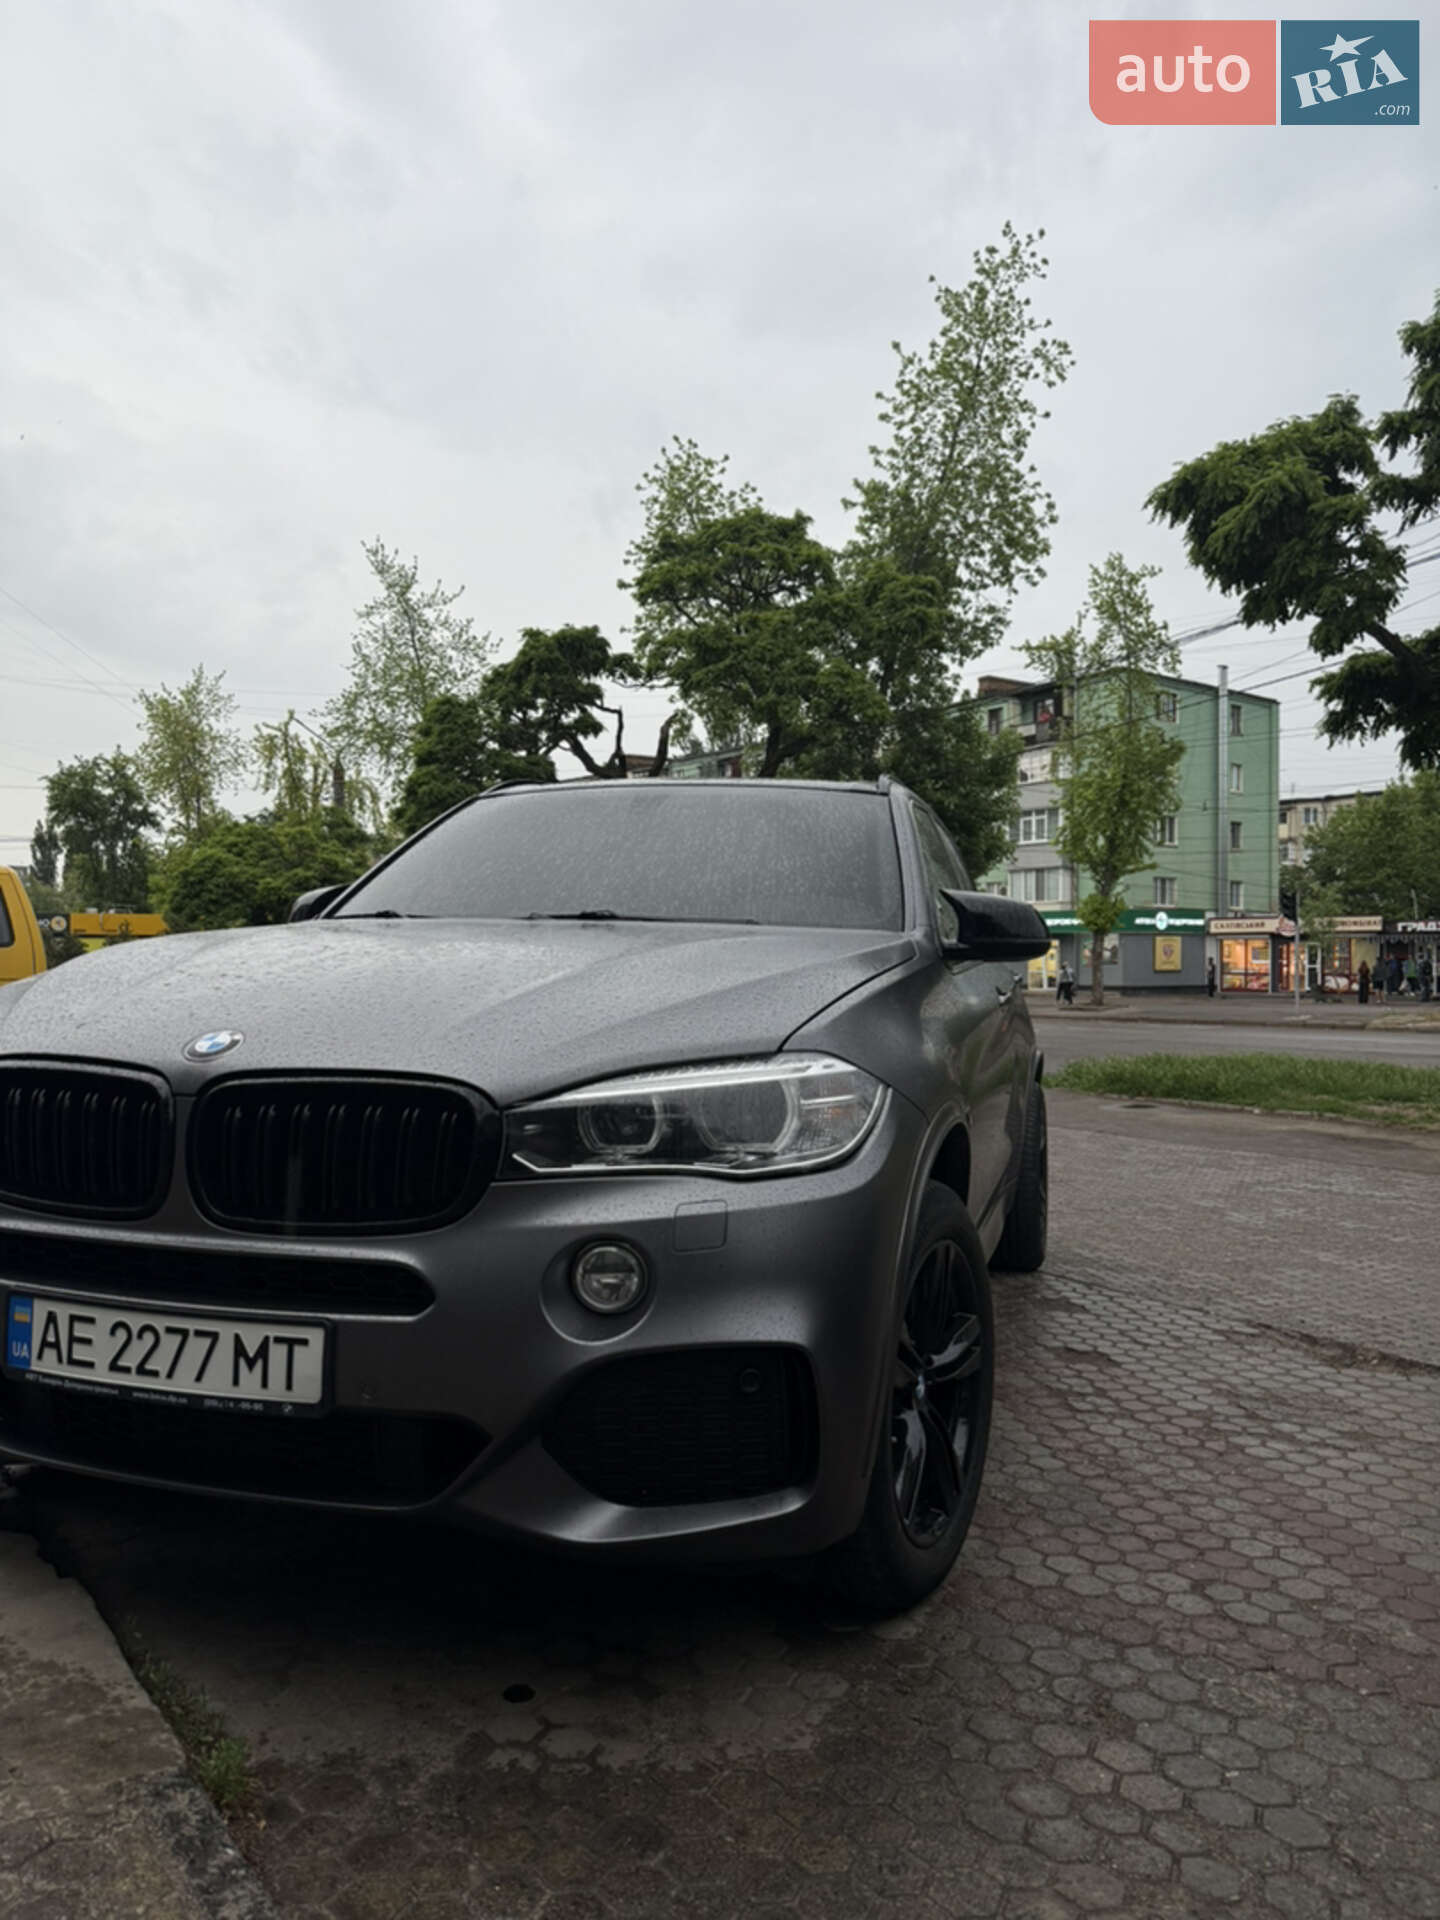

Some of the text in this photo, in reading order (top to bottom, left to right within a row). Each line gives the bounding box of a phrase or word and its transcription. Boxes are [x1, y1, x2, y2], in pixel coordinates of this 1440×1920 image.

[11, 1340, 30, 1359] UA
[36, 1310, 310, 1392] AE 2277 MT
